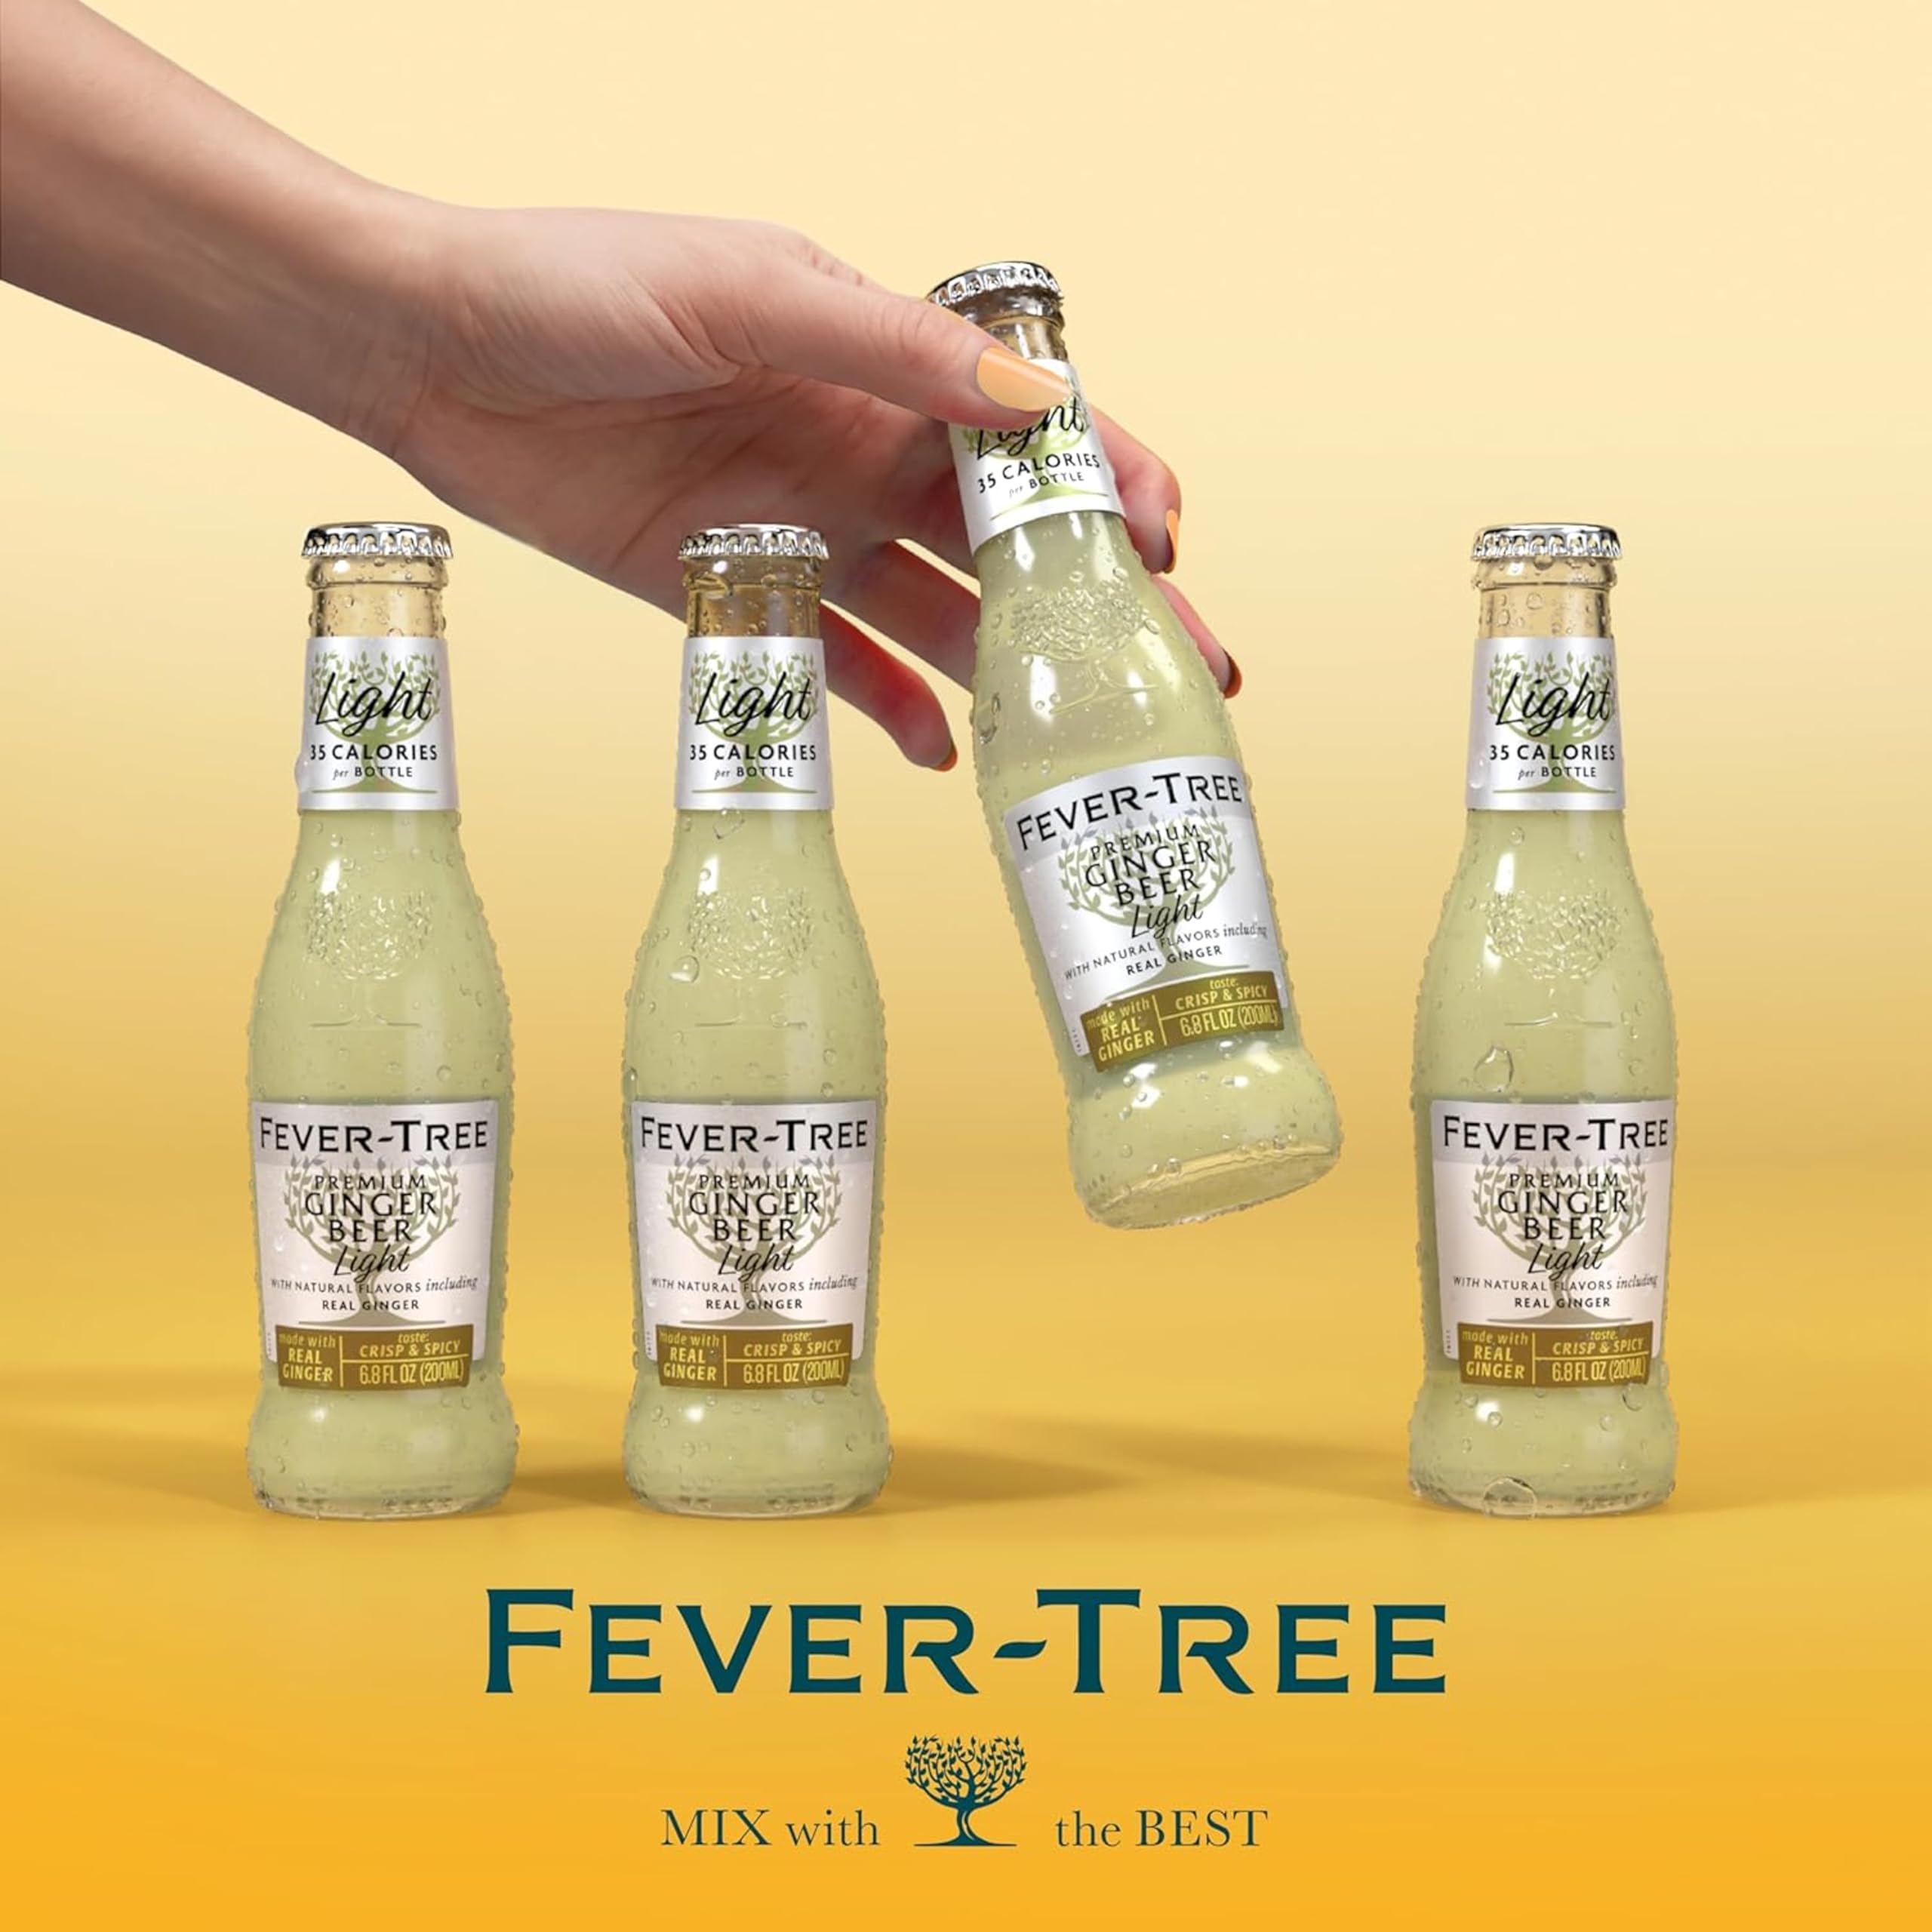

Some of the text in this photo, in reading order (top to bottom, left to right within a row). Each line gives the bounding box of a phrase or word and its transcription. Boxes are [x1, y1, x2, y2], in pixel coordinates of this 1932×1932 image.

[977, 453, 1100, 494] 35 CALORIES
[1008, 472, 1084, 498] per BOTTLE
[315, 671, 432, 737] Light
[695, 671, 811, 737] Light
[1496, 672, 1611, 737] Light
[310, 744, 438, 760] 35 CALORIES
[690, 744, 816, 760] 35 CALORIES
[1490, 744, 1615, 760] 35 CALORIES
[333, 767, 413, 780] per BOTTLE
[714, 767, 794, 780] per BOTTLE
[1518, 767, 1596, 780] per BOTTLE
[1017, 772, 1244, 851] FEVER-TREE
[1090, 824, 1199, 860] PREMIUM
[1085, 840, 1216, 888] GINGER
[1115, 868, 1199, 907] BEER
[1131, 894, 1204, 939] Light
[1064, 961, 1091, 980] WITH
[1093, 943, 1155, 969] NATURAL
[1161, 928, 1220, 948] FLAVORS
[1126, 945, 1223, 975] REAL GINGER
[1120, 996, 1151, 1017] with
[1175, 985, 1268, 1011] CRISP & SPICY
[1219, 1007, 1237, 1029] OZ
[1100, 1017, 1140, 1042] REAL
[1098, 1029, 1155, 1062] GINGER
[260, 1116, 488, 1153] FEVER-TREE
[641, 1116, 868, 1152] FEVER-TREE
[1443, 1115, 1669, 1152] FEVER-TREE
[315, 1174, 426, 1190] PREMIUM
[700, 1174, 811, 1189] PREMIUM
[1509, 1173, 1620, 1188] PREMIUM
[305, 1192, 436, 1217] GINGER
[688, 1192, 820, 1217] GINGER
[1497, 1190, 1629, 1215] GINGER
[329, 1219, 412, 1242] BEER
[714, 1218, 798, 1241] BEER
[1524, 1217, 1607, 1241] BEER
[333, 1244, 410, 1283] Light
[718, 1244, 794, 1282] Light
[1527, 1242, 1604, 1281] Light
[272, 1276, 478, 1294] WITH NATURAL FLAVORS including
[651, 1275, 859, 1293] WITH NATURAL FLAVORS including
[1454, 1274, 1659, 1292] WITH NATURAL FLAVORS including
[322, 1300, 419, 1311] REAL GINGER
[706, 1299, 803, 1310] REAL GINGER
[1515, 1297, 1611, 1309] REAL GINGER
[278, 1334, 305, 1347] made
[307, 1334, 336, 1348] with
[359, 1340, 460, 1358] CRISP & SPICY
[659, 1332, 688, 1346] made
[691, 1333, 719, 1347] with
[743, 1340, 842, 1357] CRISP & SPICY
[1463, 1331, 1494, 1343] made
[1497, 1332, 1529, 1346] with
[1552, 1338, 1644, 1355] CRISP & SPICY
[288, 1347, 322, 1364] REAL
[669, 1346, 706, 1364] REAL
[1474, 1344, 1513, 1362] REAL
[282, 1364, 333, 1383] GINGER
[400, 1364, 417, 1383] OZ
[663, 1364, 717, 1382] GINGER
[783, 1362, 800, 1383] OZ
[1466, 1361, 1525, 1380] GINGER
[1591, 1361, 1607, 1380] OZ
